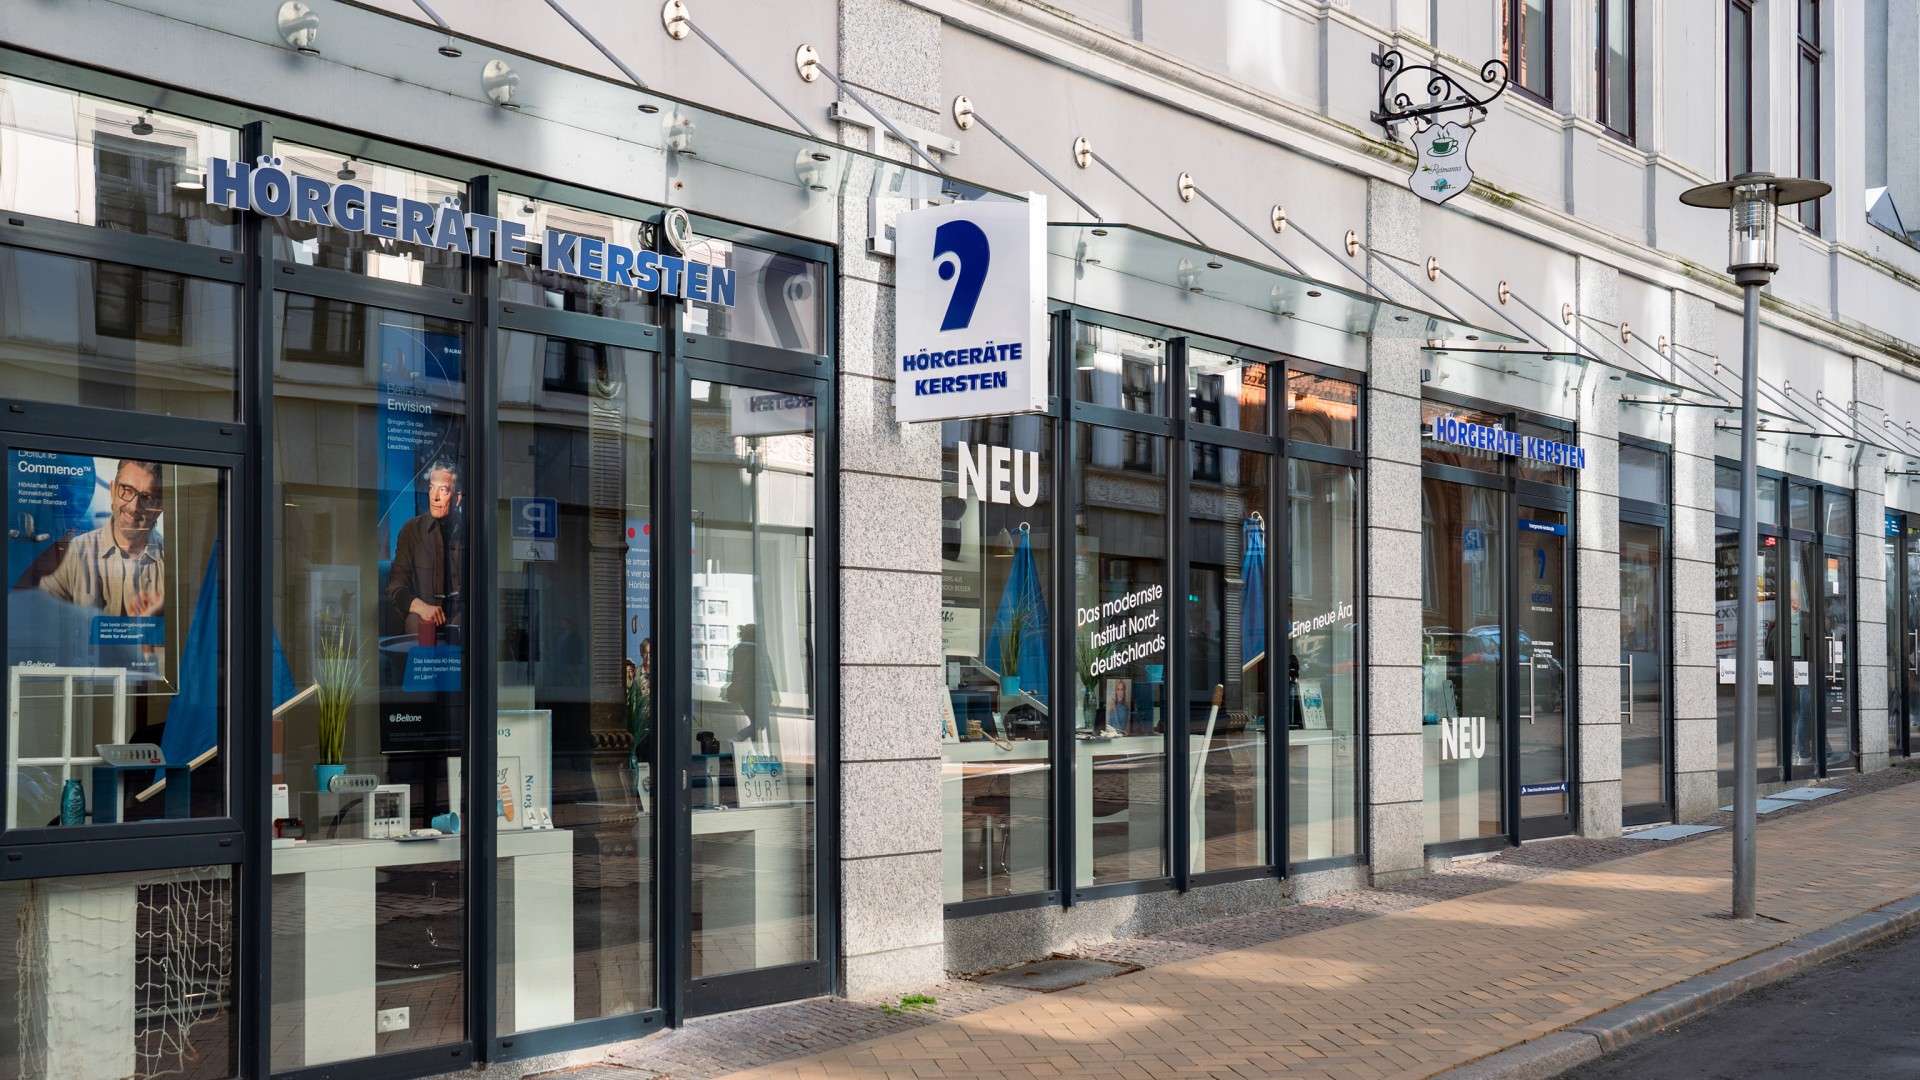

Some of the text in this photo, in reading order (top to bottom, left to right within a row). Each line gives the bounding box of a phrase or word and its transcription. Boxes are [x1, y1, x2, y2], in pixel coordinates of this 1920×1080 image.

[207, 154, 736, 308] HÖRGERÄTE KERSTEN
[903, 341, 1022, 372] HÖRGERÄTE
[388, 383, 424, 398] Beltone
[915, 371, 1008, 396] KERSTEN
[1433, 413, 1585, 469] HÖRGERÄTE KERSTEN
[958, 441, 1039, 507] NEU
[1078, 584, 1163, 627] Das modernste
[1293, 601, 1353, 638] Eine neue Ära
[1091, 609, 1159, 650] Institut Nord-
[1091, 634, 1166, 677] deutschlands
[396, 714, 422, 723] Beltone
[1442, 717, 1485, 760] NEU
[744, 780, 781, 798] SURF
